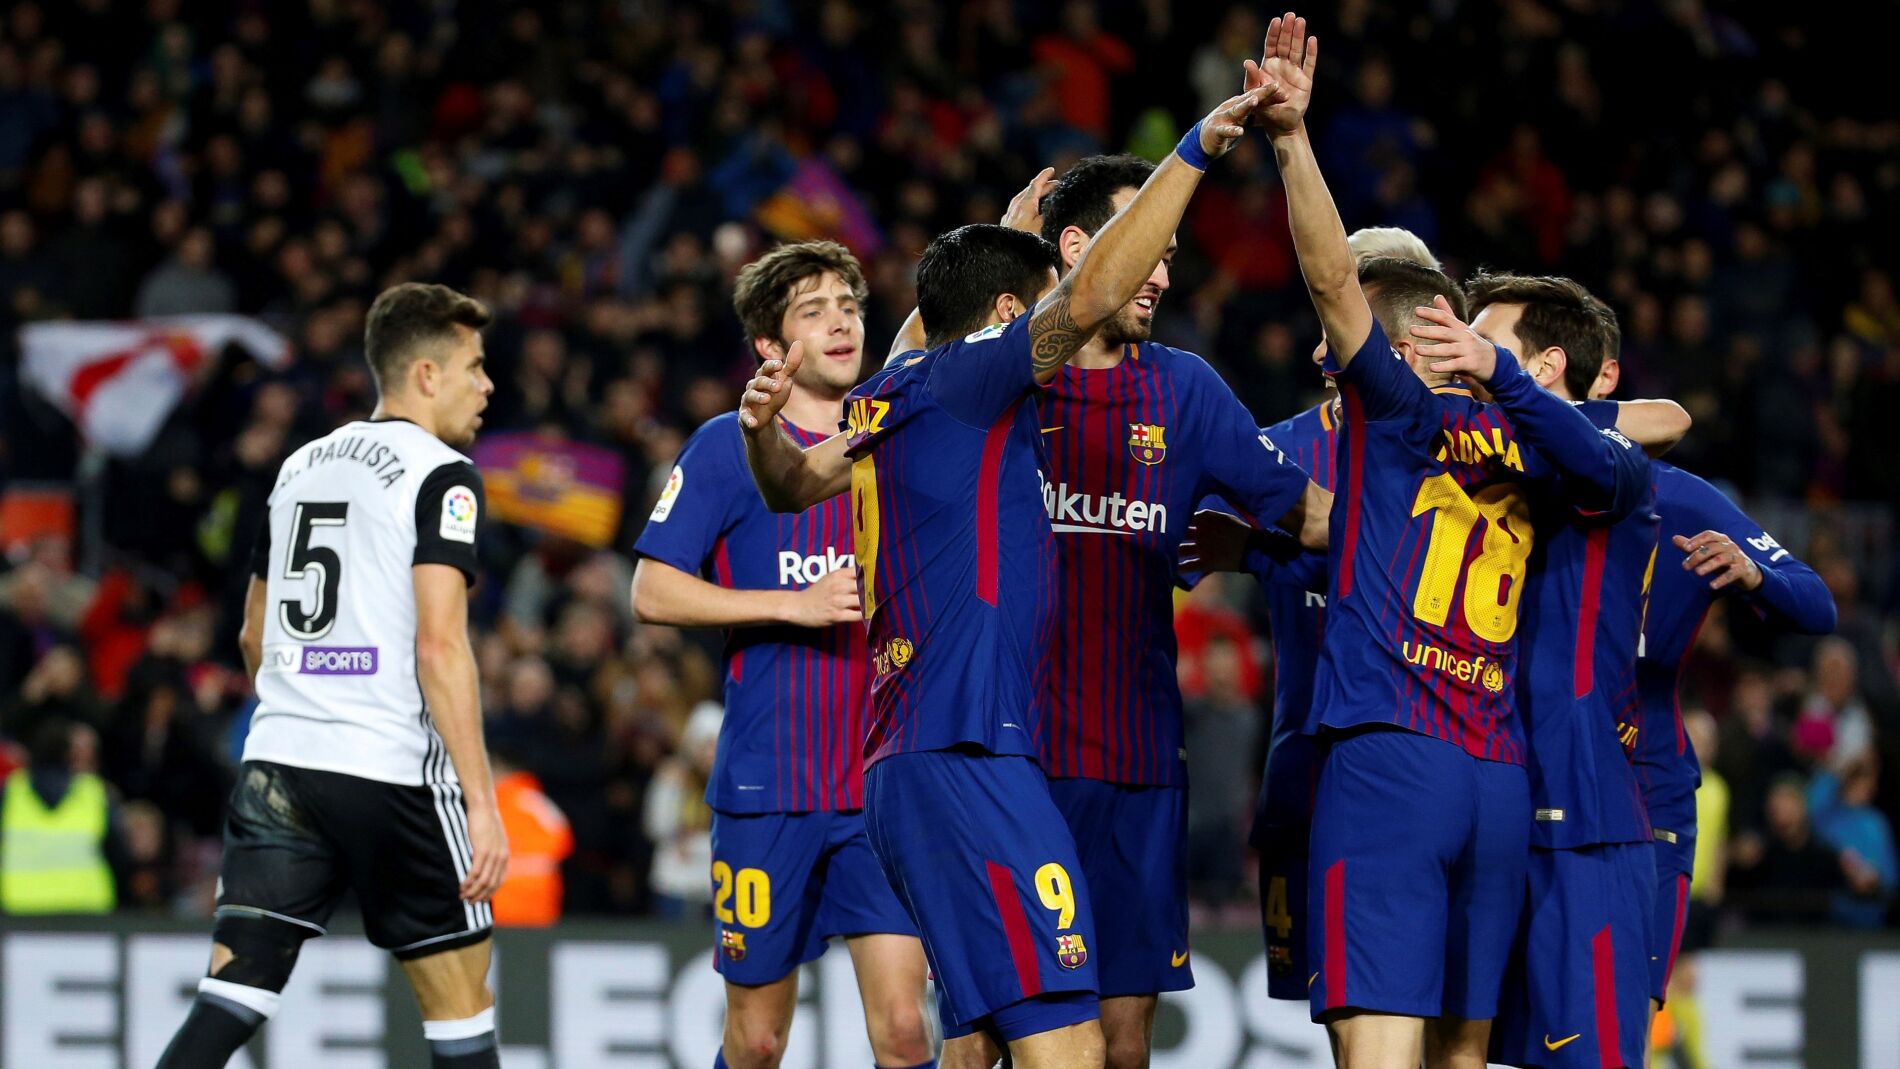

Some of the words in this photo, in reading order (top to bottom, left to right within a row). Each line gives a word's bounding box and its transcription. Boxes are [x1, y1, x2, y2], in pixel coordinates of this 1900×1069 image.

[308, 436, 406, 490] PAULISTA
[1037, 469, 1167, 534] akuten
[279, 502, 350, 642] 5
[779, 546, 856, 586] Rak
[1411, 472, 1535, 643] 18
[305, 650, 373, 671] SPORTS
[1402, 641, 1486, 685] unicef
[711, 860, 771, 929] 20
[1034, 862, 1076, 930] 9
[1266, 876, 1292, 938] 4
